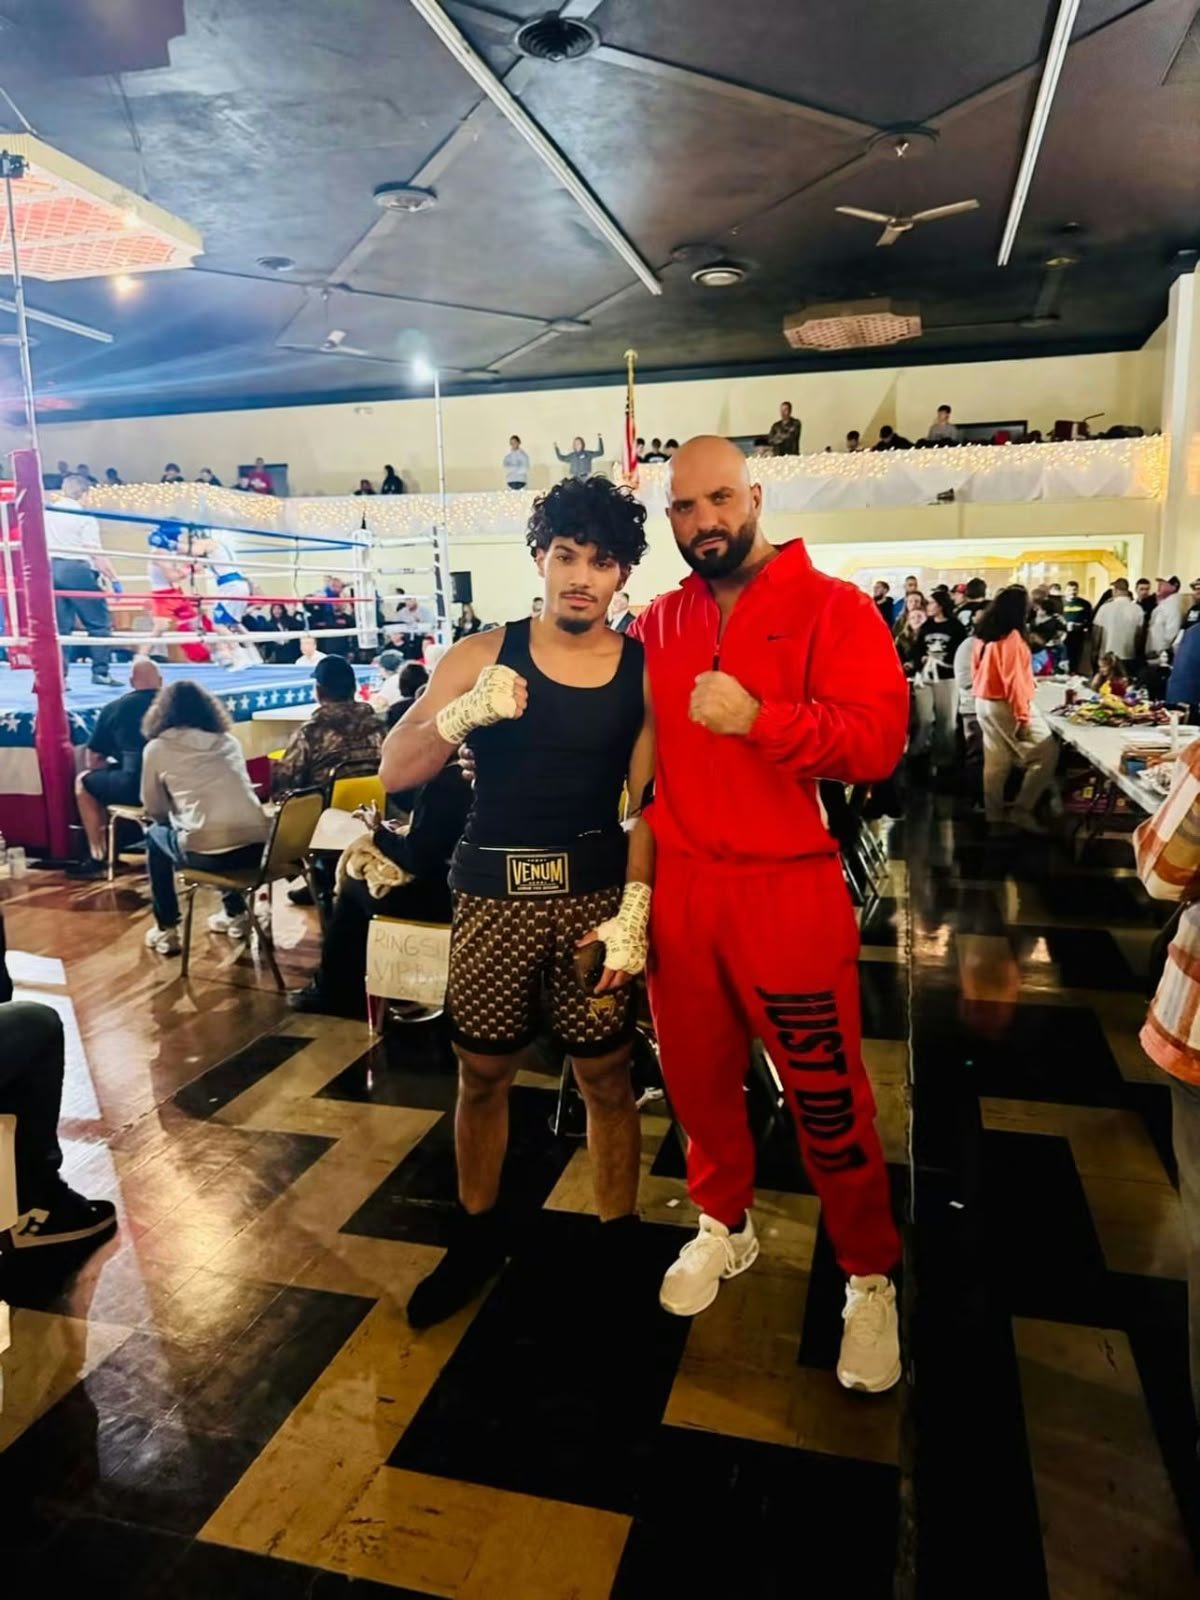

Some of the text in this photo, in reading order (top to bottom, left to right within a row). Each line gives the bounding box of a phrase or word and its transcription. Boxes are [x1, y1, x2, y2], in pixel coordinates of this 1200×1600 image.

[512, 858, 563, 885] VENUM
[755, 986, 848, 1075] JUST
[794, 1087, 855, 1140] DO
